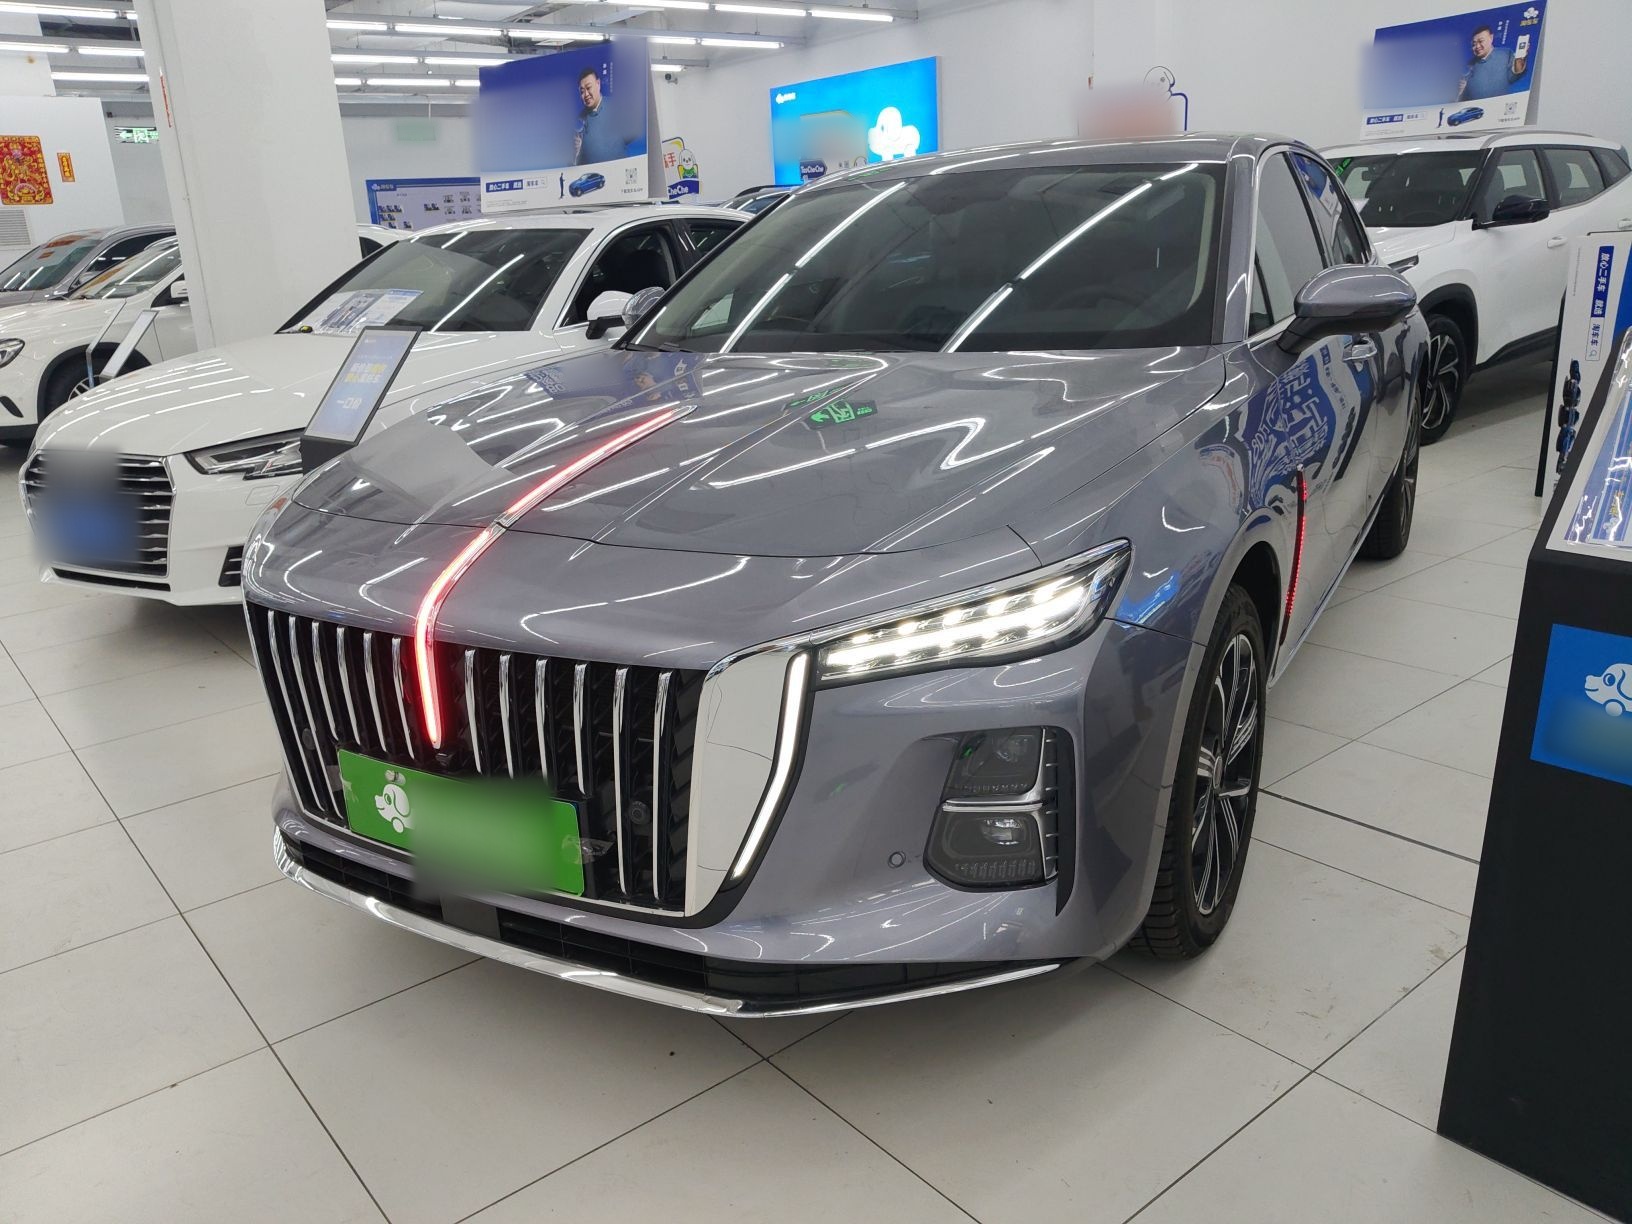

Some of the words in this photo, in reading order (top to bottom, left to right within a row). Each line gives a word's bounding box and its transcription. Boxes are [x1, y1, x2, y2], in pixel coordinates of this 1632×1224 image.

[1597, 252, 1610, 293] 放心二手车
[1590, 323, 1600, 347] 淘车车
